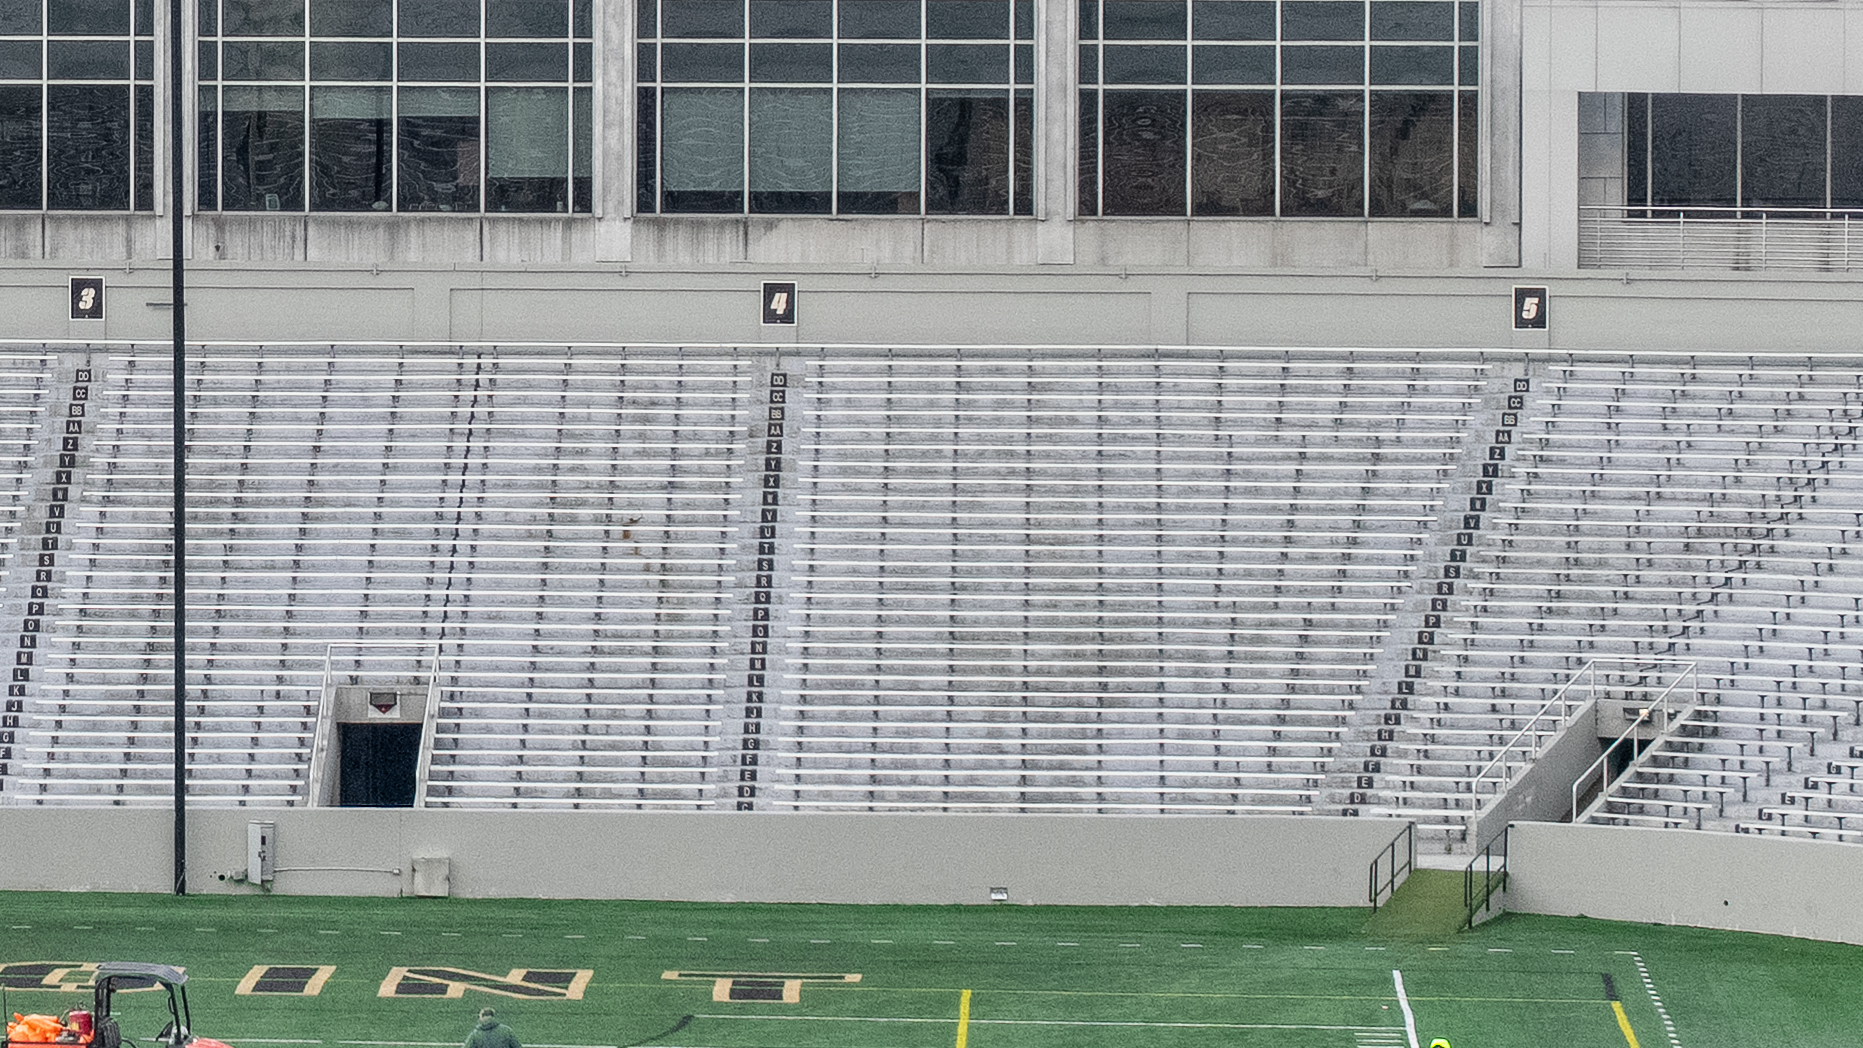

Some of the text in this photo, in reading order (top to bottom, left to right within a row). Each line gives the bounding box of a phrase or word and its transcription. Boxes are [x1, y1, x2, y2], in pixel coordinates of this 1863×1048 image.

[79, 288, 97, 311] 3
[771, 293, 789, 316] 4
[1522, 298, 1540, 321] 5
[78, 371, 90, 381] DD
[772, 375, 785, 386] DD
[1516, 381, 1528, 391] DD
[75, 388, 86, 399] CC
[772, 392, 784, 402] CC
[1510, 397, 1521, 408] CC
[68, 422, 80, 433] AA
[770, 425, 782, 435] AA
[1497, 432, 1510, 442] AA
[67, 439, 74, 450] Z
[770, 442, 778, 453] Z
[1493, 448, 1501, 459] Z
[64, 455, 70, 466] Y
[770, 459, 776, 470] Y
[1487, 465, 1494, 476] Y
[61, 472, 67, 483] X
[768, 477, 775, 487] X
[1481, 482, 1488, 493] X
[53, 506, 60, 517] V
[765, 511, 773, 521] V
[50, 523, 57, 533] U
[1469, 518, 1476, 528] V
[764, 527, 772, 538] U
[47, 539, 54, 549] T
[1460, 534, 1469, 545] U
[763, 543, 770, 554] T
[43, 555, 50, 566] S
[1454, 550, 1462, 561] T
[762, 560, 769, 571] S
[40, 571, 47, 581] R
[1448, 567, 1456, 578] S
[760, 576, 768, 587] R
[35, 587, 43, 597] Q
[1441, 583, 1449, 594] R
[759, 592, 766, 602] Q
[32, 603, 39, 614] P
[1435, 600, 1443, 610] Q
[757, 609, 765, 620] P
[1428, 616, 1436, 627] P
[24, 636, 31, 647] N
[755, 643, 763, 653] N
[1416, 648, 1424, 659] N
[17, 669, 24, 680] L
[753, 675, 760, 686] L
[13, 685, 20, 696] K
[1402, 682, 1410, 693] L
[751, 692, 759, 703] K
[11, 700, 18, 711] J
[1394, 699, 1403, 709] K
[750, 708, 757, 718] J
[6, 716, 13, 726] H
[1388, 714, 1395, 725] J
[748, 723, 756, 733] H
[2, 732, 9, 743] G
[1381, 729, 1389, 740] H
[747, 738, 755, 749] G
[0, 748, 6, 758] F
[1374, 745, 1382, 756] G
[746, 754, 753, 765] F
[1368, 761, 1375, 771] F
[744, 771, 751, 781] E
[1361, 776, 1368, 788] E
[743, 786, 751, 797] D
[1354, 792, 1361, 803] D
